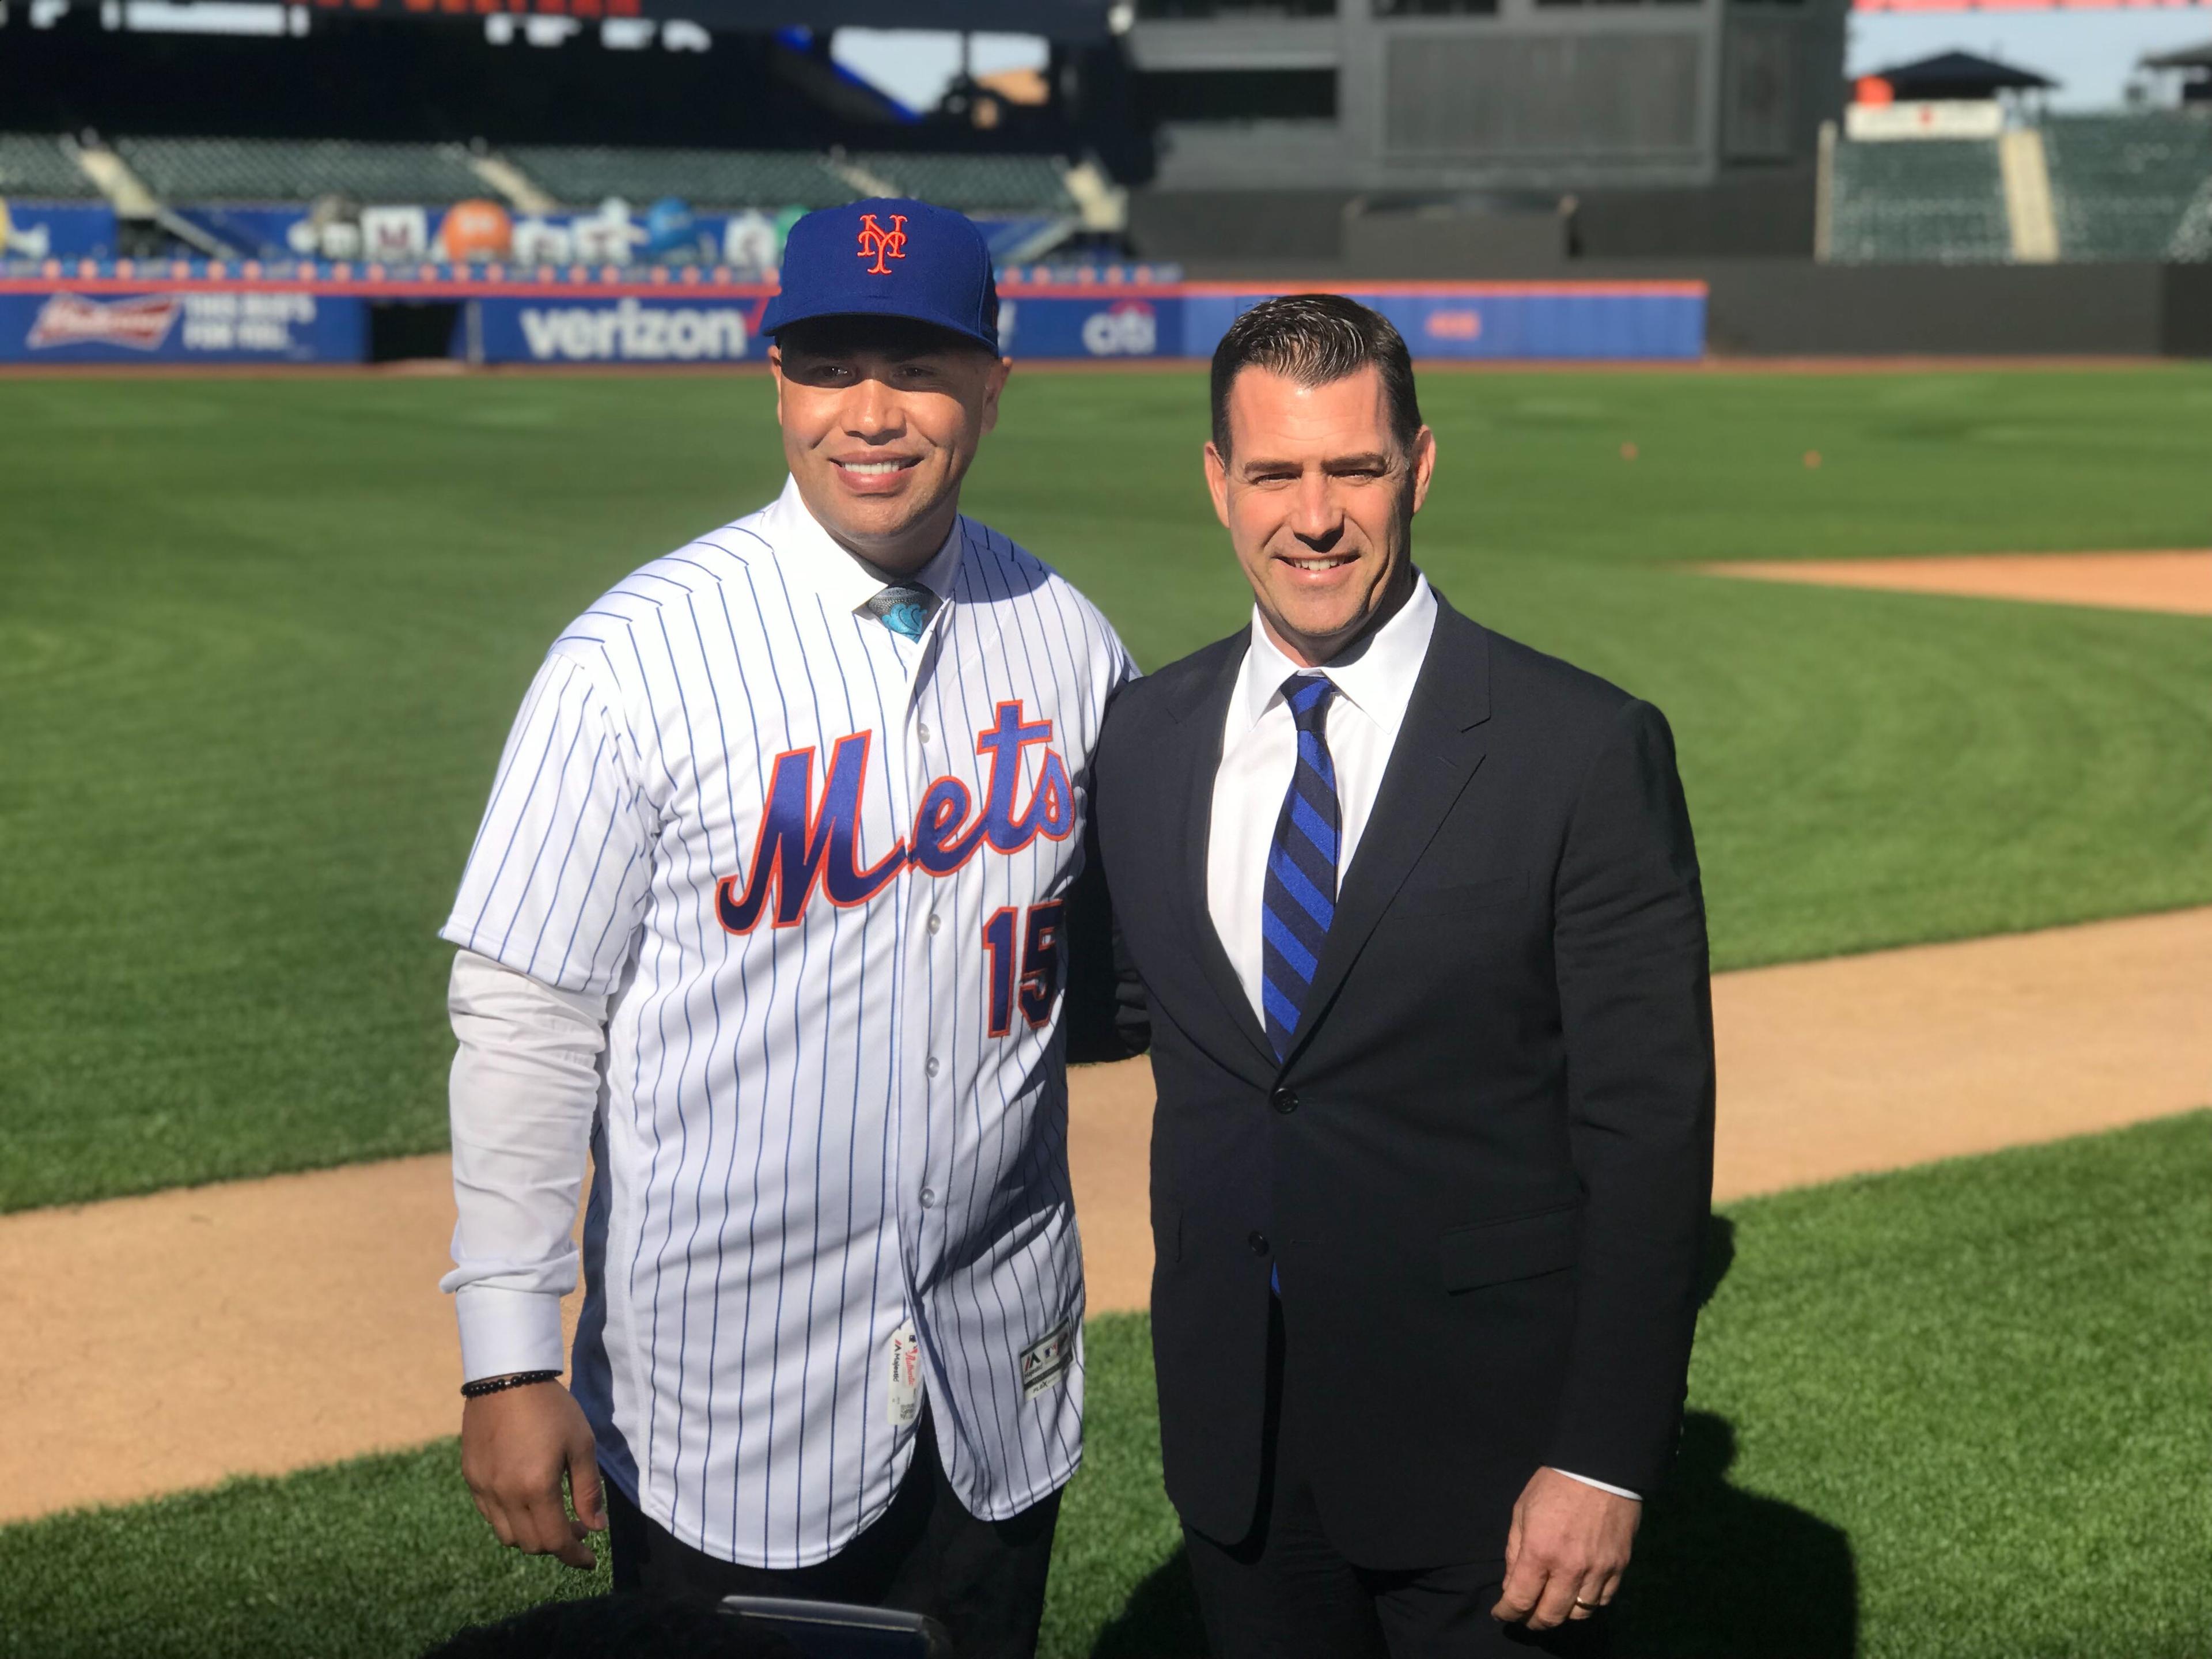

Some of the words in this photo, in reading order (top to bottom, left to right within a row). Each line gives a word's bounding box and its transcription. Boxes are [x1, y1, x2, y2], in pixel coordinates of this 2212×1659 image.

[857, 213, 908, 275] NY
[520, 296, 748, 359] verizon
[715, 699, 1075, 936] Mets
[982, 897, 1065, 1039] 15
